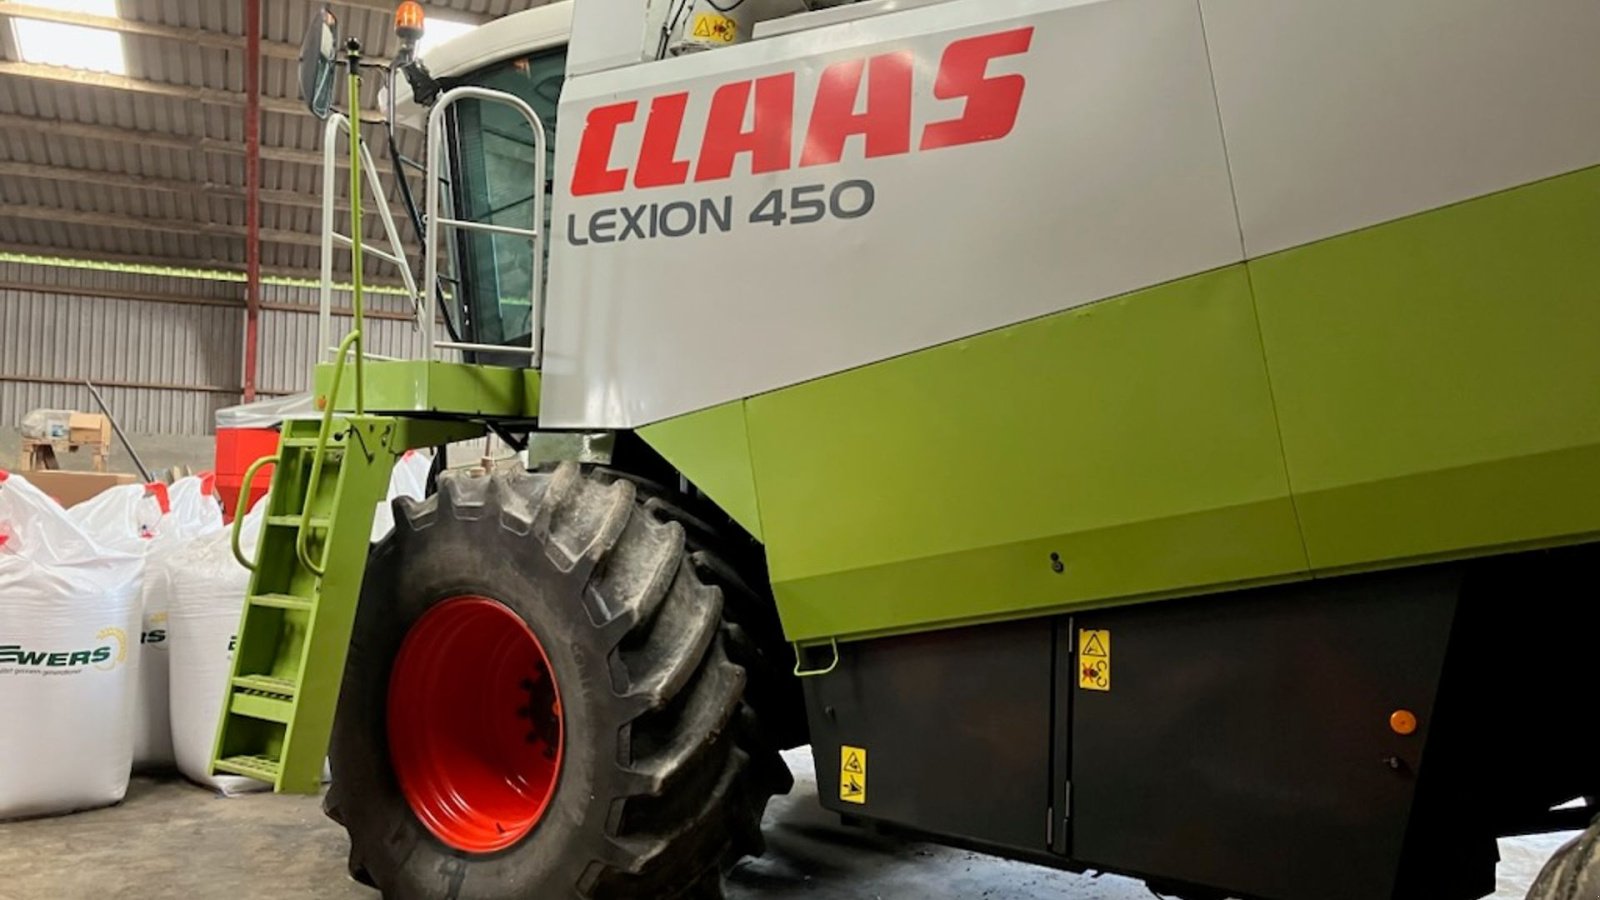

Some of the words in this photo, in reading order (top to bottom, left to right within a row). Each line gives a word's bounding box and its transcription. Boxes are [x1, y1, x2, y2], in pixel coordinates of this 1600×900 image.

[570, 26, 1035, 197] CLAAS
[567, 195, 733, 246] LEXION
[749, 179, 875, 227] 450
